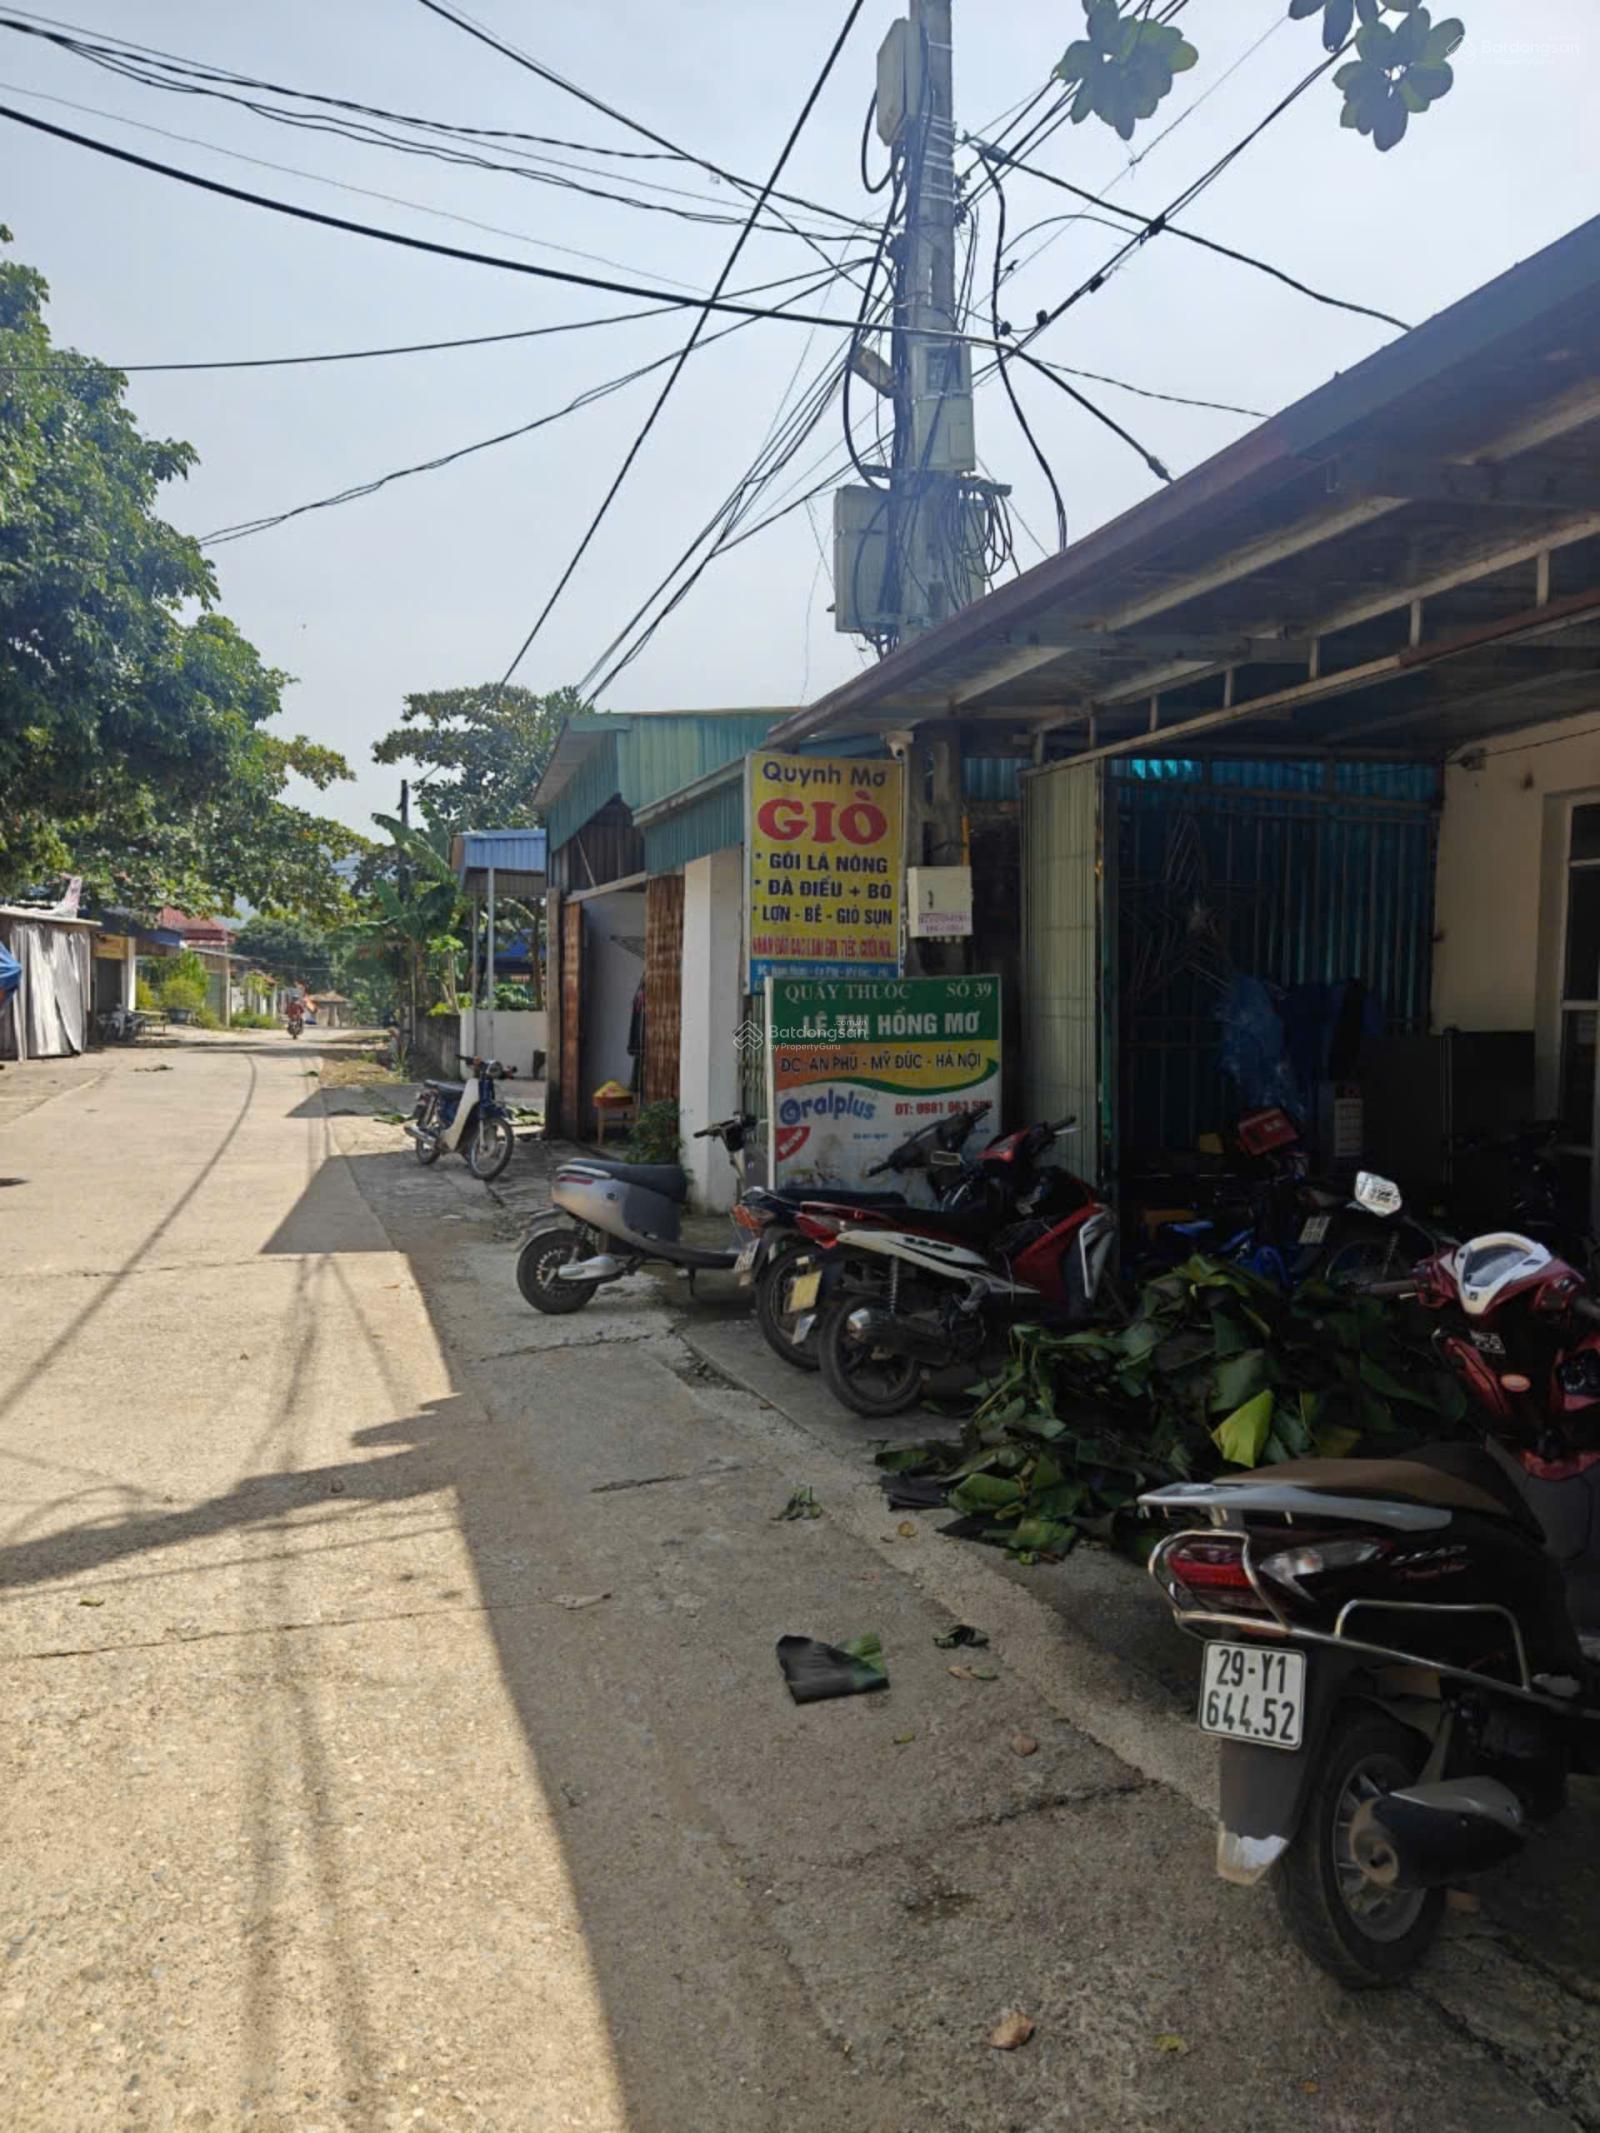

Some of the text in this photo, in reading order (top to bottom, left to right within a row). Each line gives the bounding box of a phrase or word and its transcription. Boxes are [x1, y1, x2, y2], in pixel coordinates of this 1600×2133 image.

[851, 766, 887, 787] Mơ
[757, 789, 888, 846] GIÒ
[768, 875, 794, 896] ĐÀ
[848, 886, 861, 897] +
[864, 907, 893, 929] SỤN
[974, 982, 992, 998] 39
[945, 1010, 981, 1034] MƠ
[809, 1056, 829, 1071] AN
[833, 1051, 857, 1071] PHÚ
[871, 1050, 891, 1070] MỸ
[895, 1050, 922, 1069] ĐỨC
[936, 1049, 954, 1068] HÀ
[958, 1048, 981, 1070] NỘI
[1216, 1648, 1287, 1694] 29-Y1
[1206, 1689, 1297, 1741] 644.52
